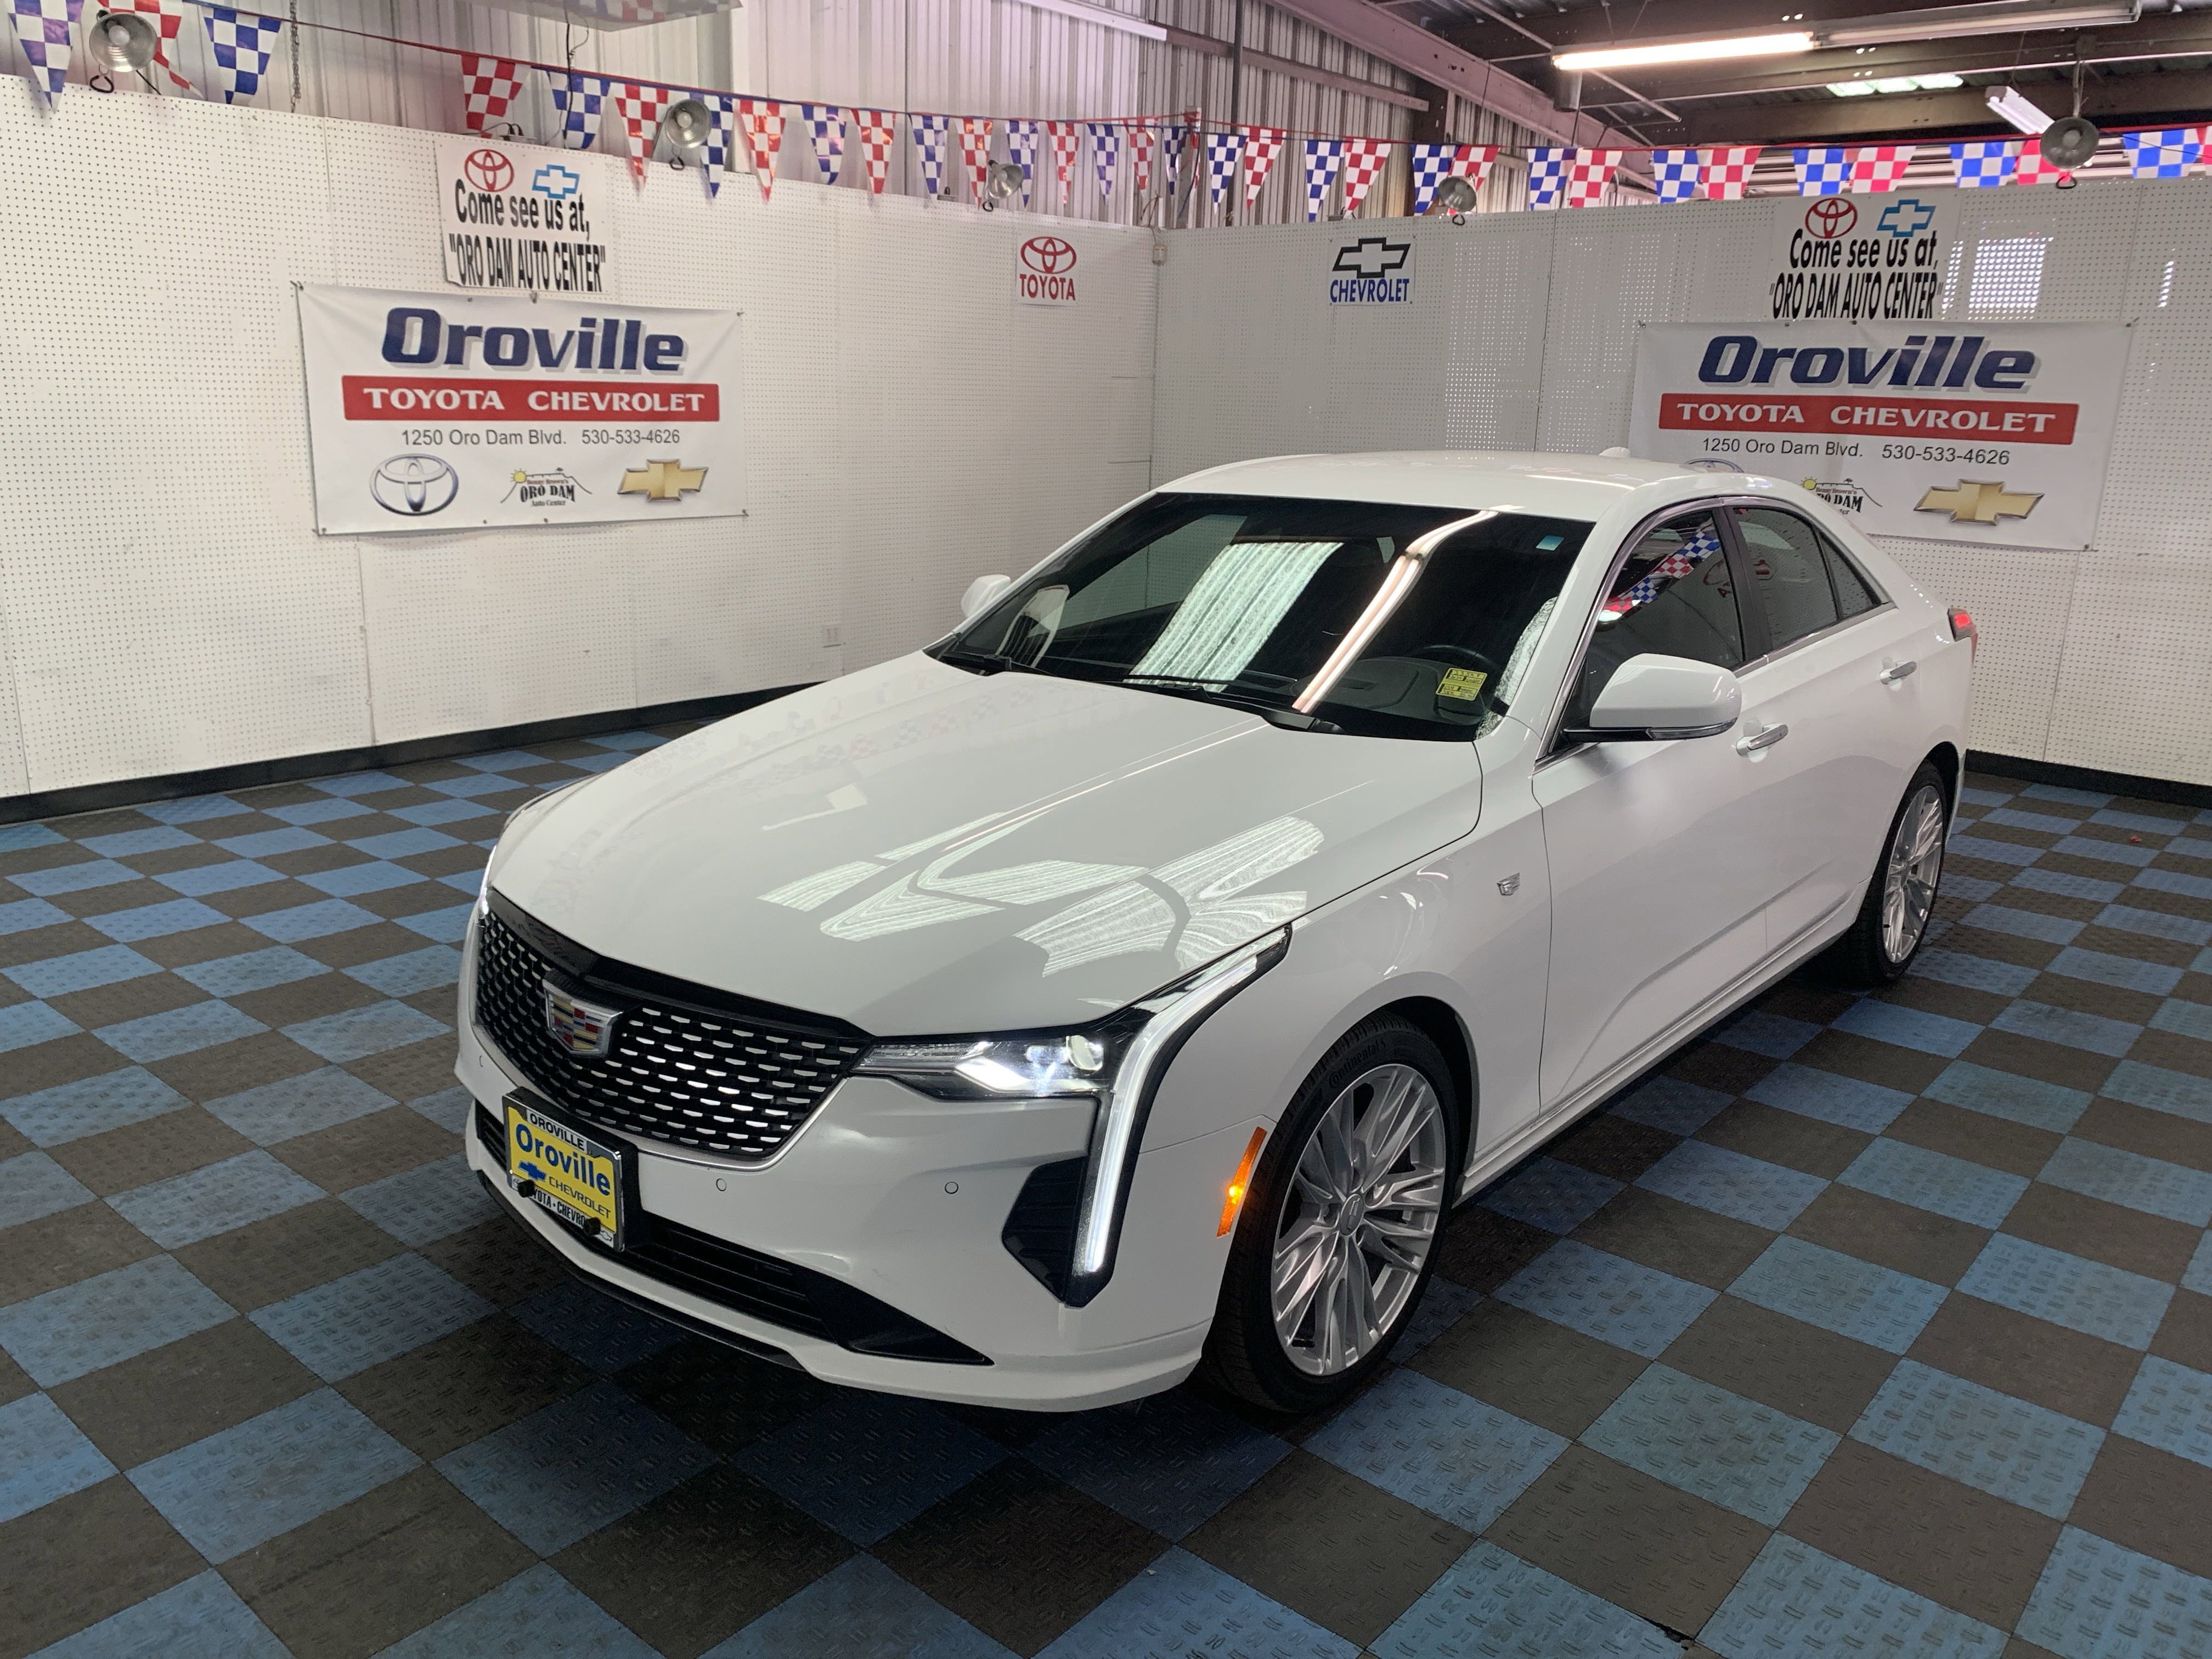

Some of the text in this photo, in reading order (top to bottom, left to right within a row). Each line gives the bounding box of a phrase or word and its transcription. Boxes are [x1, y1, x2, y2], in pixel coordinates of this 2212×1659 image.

[455, 179, 590, 241] Come see us at,
[449, 233, 606, 292] "ORO DAM AUTO CENTER"
[1790, 228, 1938, 270] Come see us at,
[1019, 273, 1076, 301] TOYOTA
[1330, 278, 1409, 303] CHEVROLET
[1805, 273, 1841, 318] DAM
[1841, 271, 1882, 319] AUTO
[382, 308, 686, 373] Oroville
[1699, 335, 2038, 391] Oroville
[363, 387, 705, 412] TOYOTA CHEVROLET
[1677, 403, 2056, 433] TOYOTA CHEVROLET
[402, 429, 680, 445] 1250 Oro Dam Blvd. 530-533-4626
[1702, 438, 2010, 465] 1250 Oro Dam Blvd. 530-533-4626
[520, 484, 575, 503] ORO DAM
[1833, 494, 1864, 513] DAM
[529, 1113, 584, 1151] OROVILLE
[516, 1123, 611, 1196] Oroville
[549, 1176, 611, 1219] CHEVROLET
[557, 1201, 586, 1227] CHEVRO
